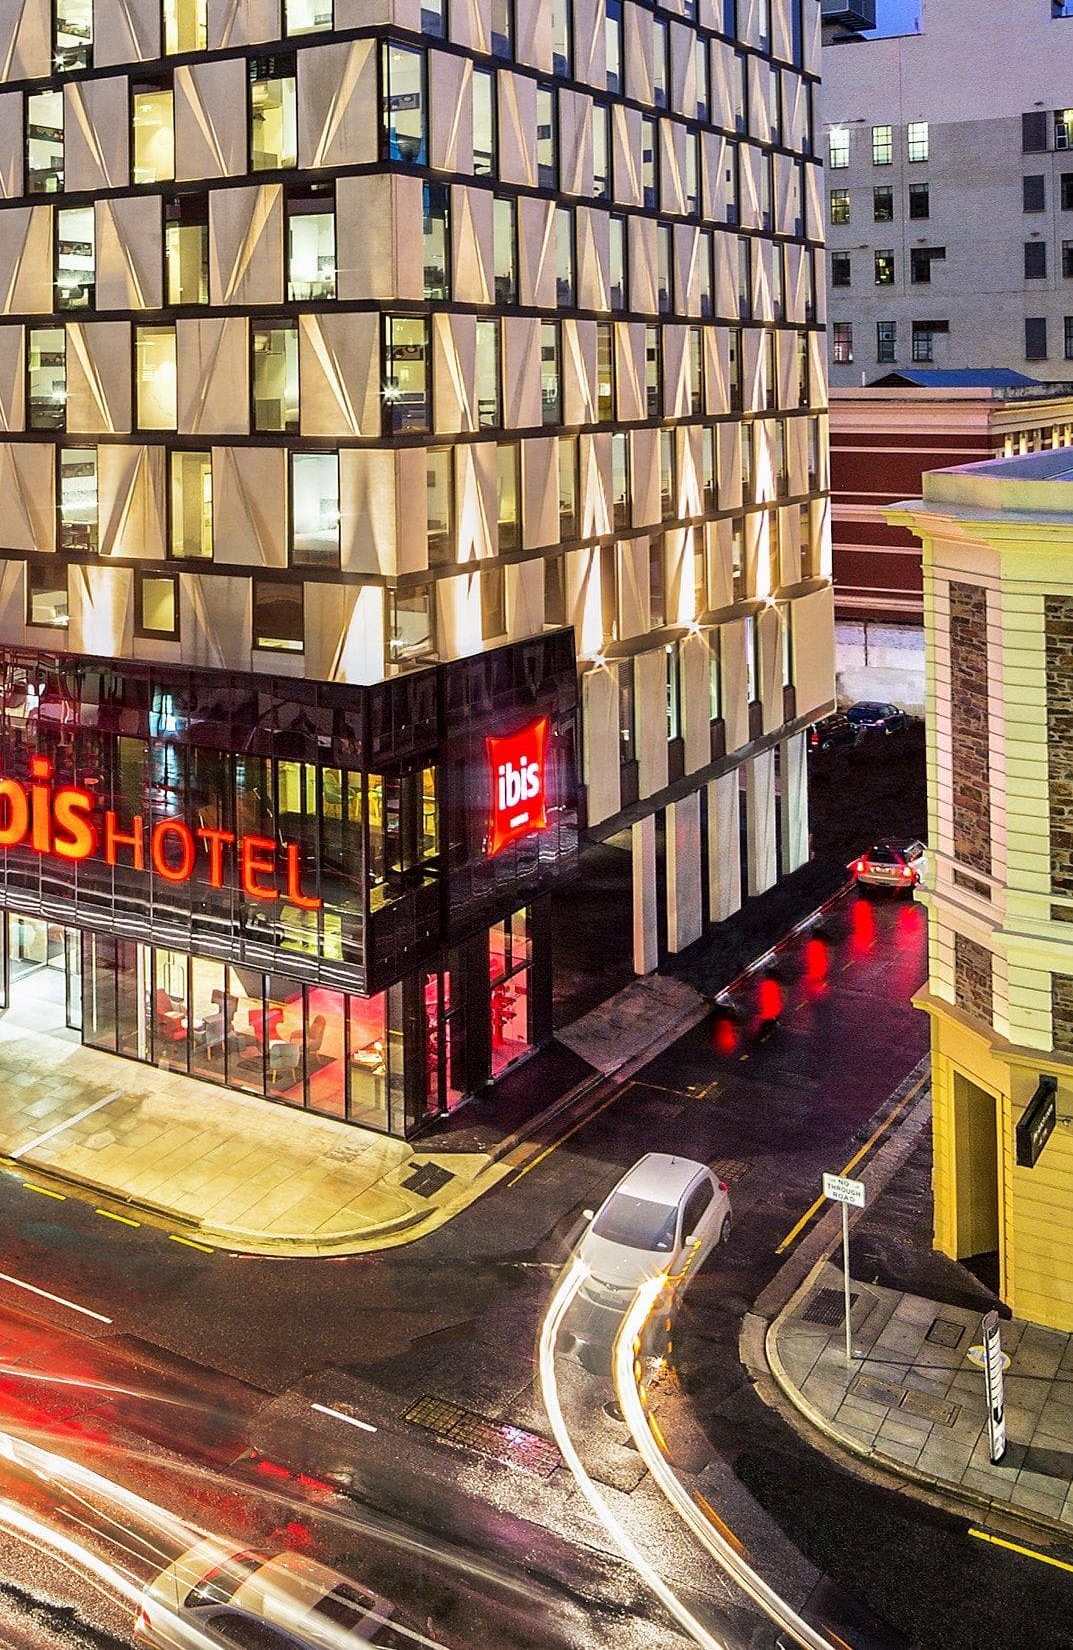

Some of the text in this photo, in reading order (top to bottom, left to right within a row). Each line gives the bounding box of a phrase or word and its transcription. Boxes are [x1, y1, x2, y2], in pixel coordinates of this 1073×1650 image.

[498, 755, 540, 811] ibis
[104, 809, 324, 911] HOTEL
[828, 1183, 861, 1197] THROUGH
[838, 1179, 850, 1187] NO
[832, 1191, 856, 1202] ROAD
